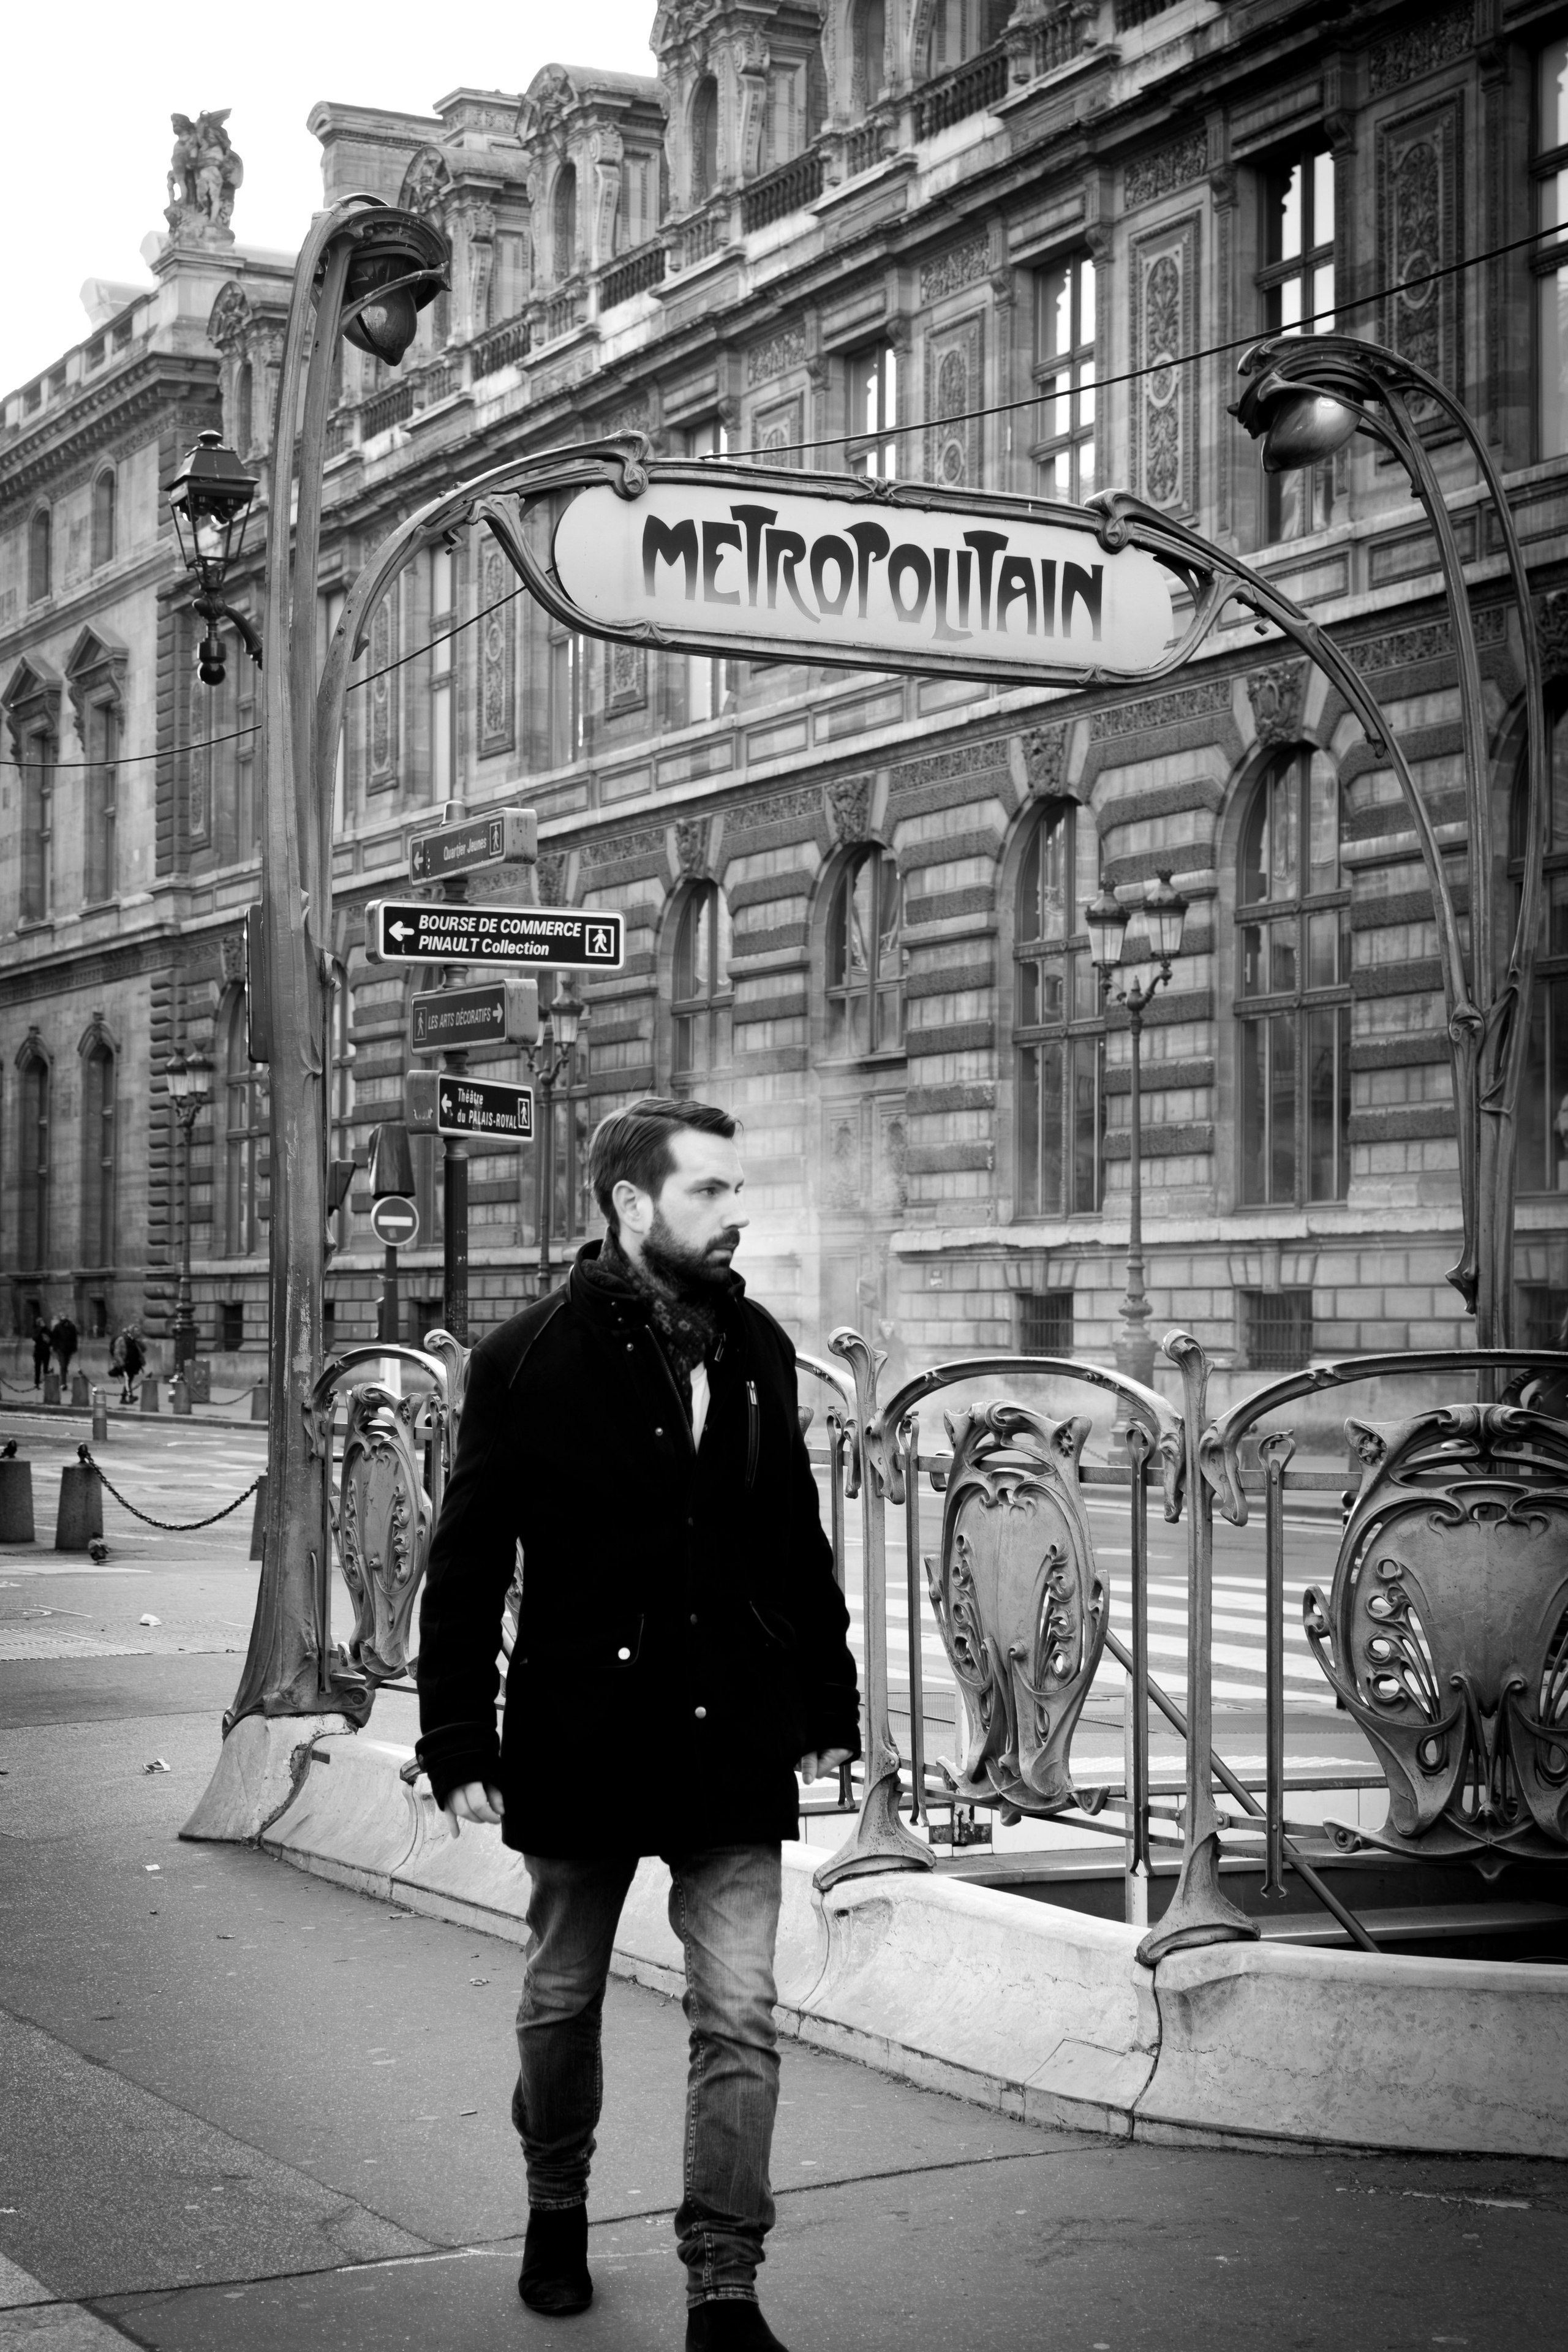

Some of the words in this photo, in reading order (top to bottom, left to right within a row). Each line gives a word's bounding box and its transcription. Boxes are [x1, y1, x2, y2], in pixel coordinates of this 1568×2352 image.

[642, 505, 1104, 642] METROPOLITAIN
[443, 843, 466, 861] Quartier
[467, 837, 487, 853] Jeunes
[419, 914, 477, 932] BOURSE
[478, 918, 498, 933] DE
[500, 919, 582, 937] COMMERCE
[419, 935, 480, 952] PINAULT
[481, 938, 549, 956] Collection
[428, 1014, 439, 1030] LES
[439, 1012, 454, 1028] ARTS
[456, 1008, 491, 1026] DÉCORATIFS
[458, 1087, 483, 1105] Théâtre
[457, 1109, 466, 1123] du
[469, 1109, 517, 1129] PALAIS-ROYAL
